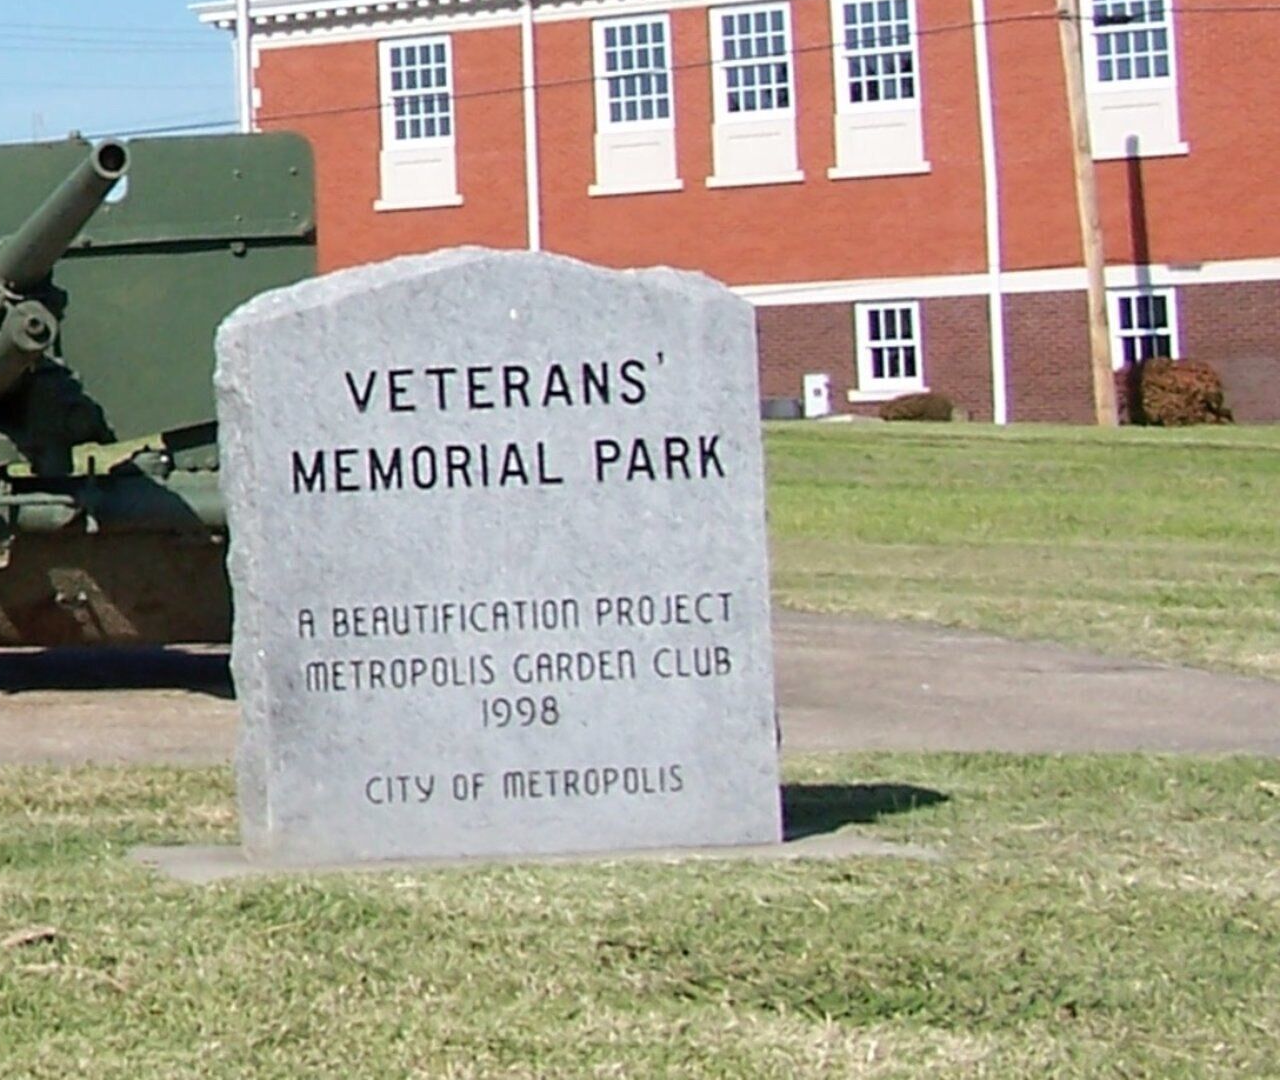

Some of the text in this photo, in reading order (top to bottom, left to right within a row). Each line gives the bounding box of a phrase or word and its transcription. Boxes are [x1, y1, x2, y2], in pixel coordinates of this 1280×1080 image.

[292, 435, 726, 494] MEMORIAL PARK
[298, 592, 734, 638] A BEAUTIFICATION PROJECT
[306, 645, 732, 692] METROPOLIS GARDEN CLUB
[482, 697, 560, 727] 1998
[366, 765, 683, 804] CITY OF METROPOLIS
